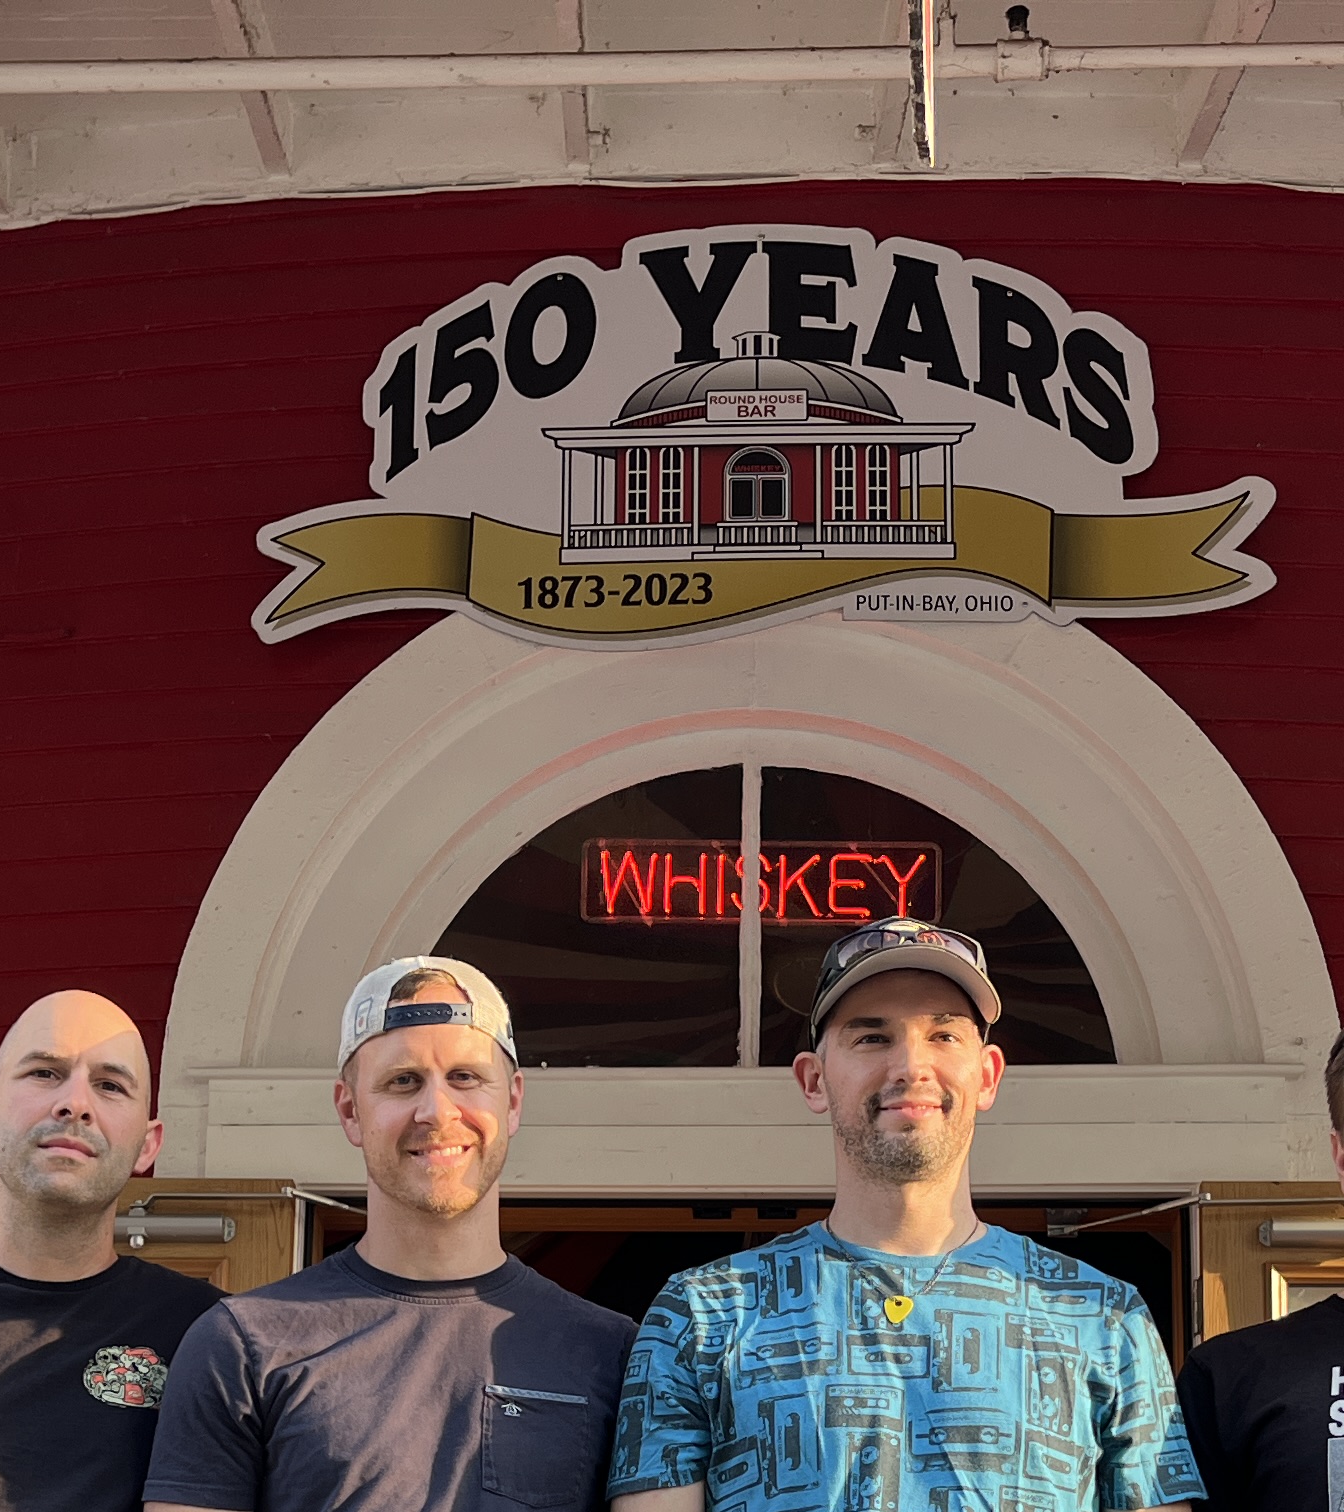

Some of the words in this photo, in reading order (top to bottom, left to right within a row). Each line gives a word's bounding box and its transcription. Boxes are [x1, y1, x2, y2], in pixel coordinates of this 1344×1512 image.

[379, 272, 597, 483] 150
[639, 240, 1133, 465] YEARS
[709, 395, 756, 405] ROUND
[759, 394, 804, 404] HOUSE
[737, 405, 777, 418] BAR
[734, 465, 782, 473] WHISKEY
[517, 572, 714, 609] 1873-2023
[856, 594, 959, 614] PUT-IN-BAY,
[964, 594, 1014, 612] OHIO
[600, 850, 927, 918] WHISKEY
